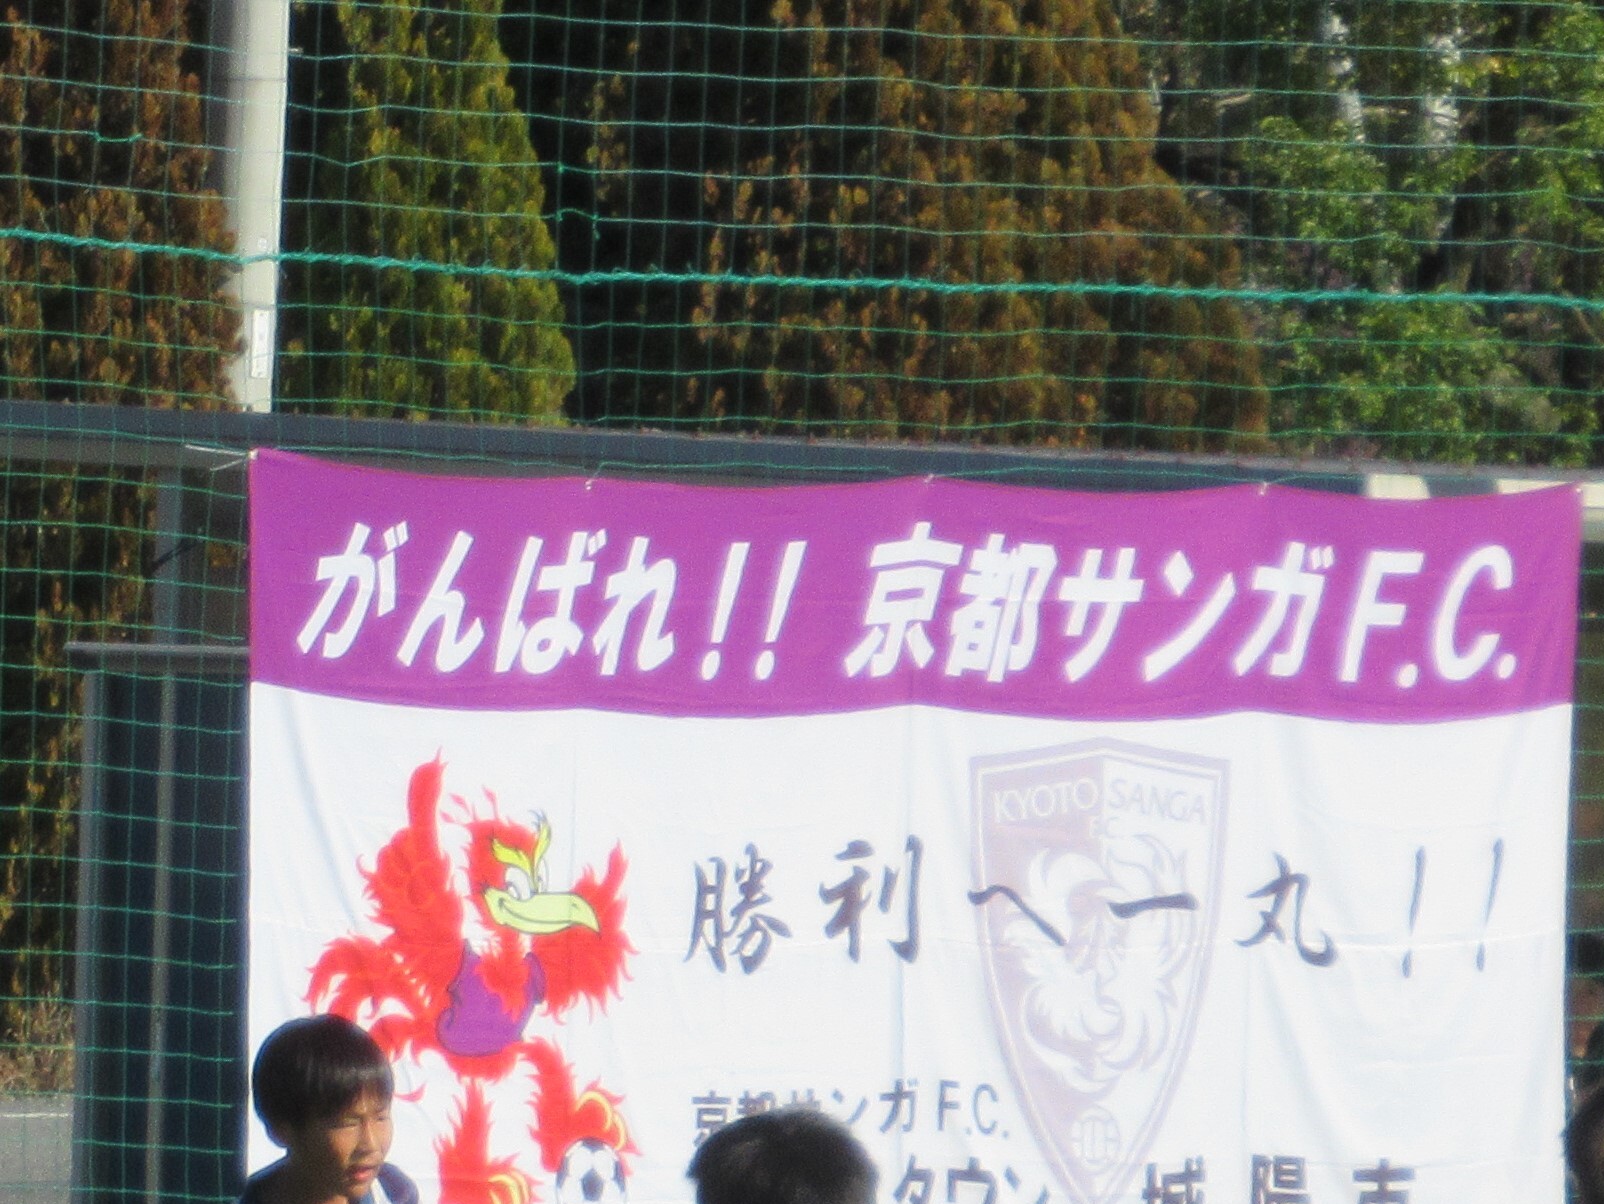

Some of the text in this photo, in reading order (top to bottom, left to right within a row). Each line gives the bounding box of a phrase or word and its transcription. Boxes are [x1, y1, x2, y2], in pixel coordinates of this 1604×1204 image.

[297, 521, 1517, 688] がんばれ!! 京都サンガF.C.
[993, 778, 1206, 824] KYOTO SANGA
[683, 835, 1505, 977] 勝利へ一丸!!
